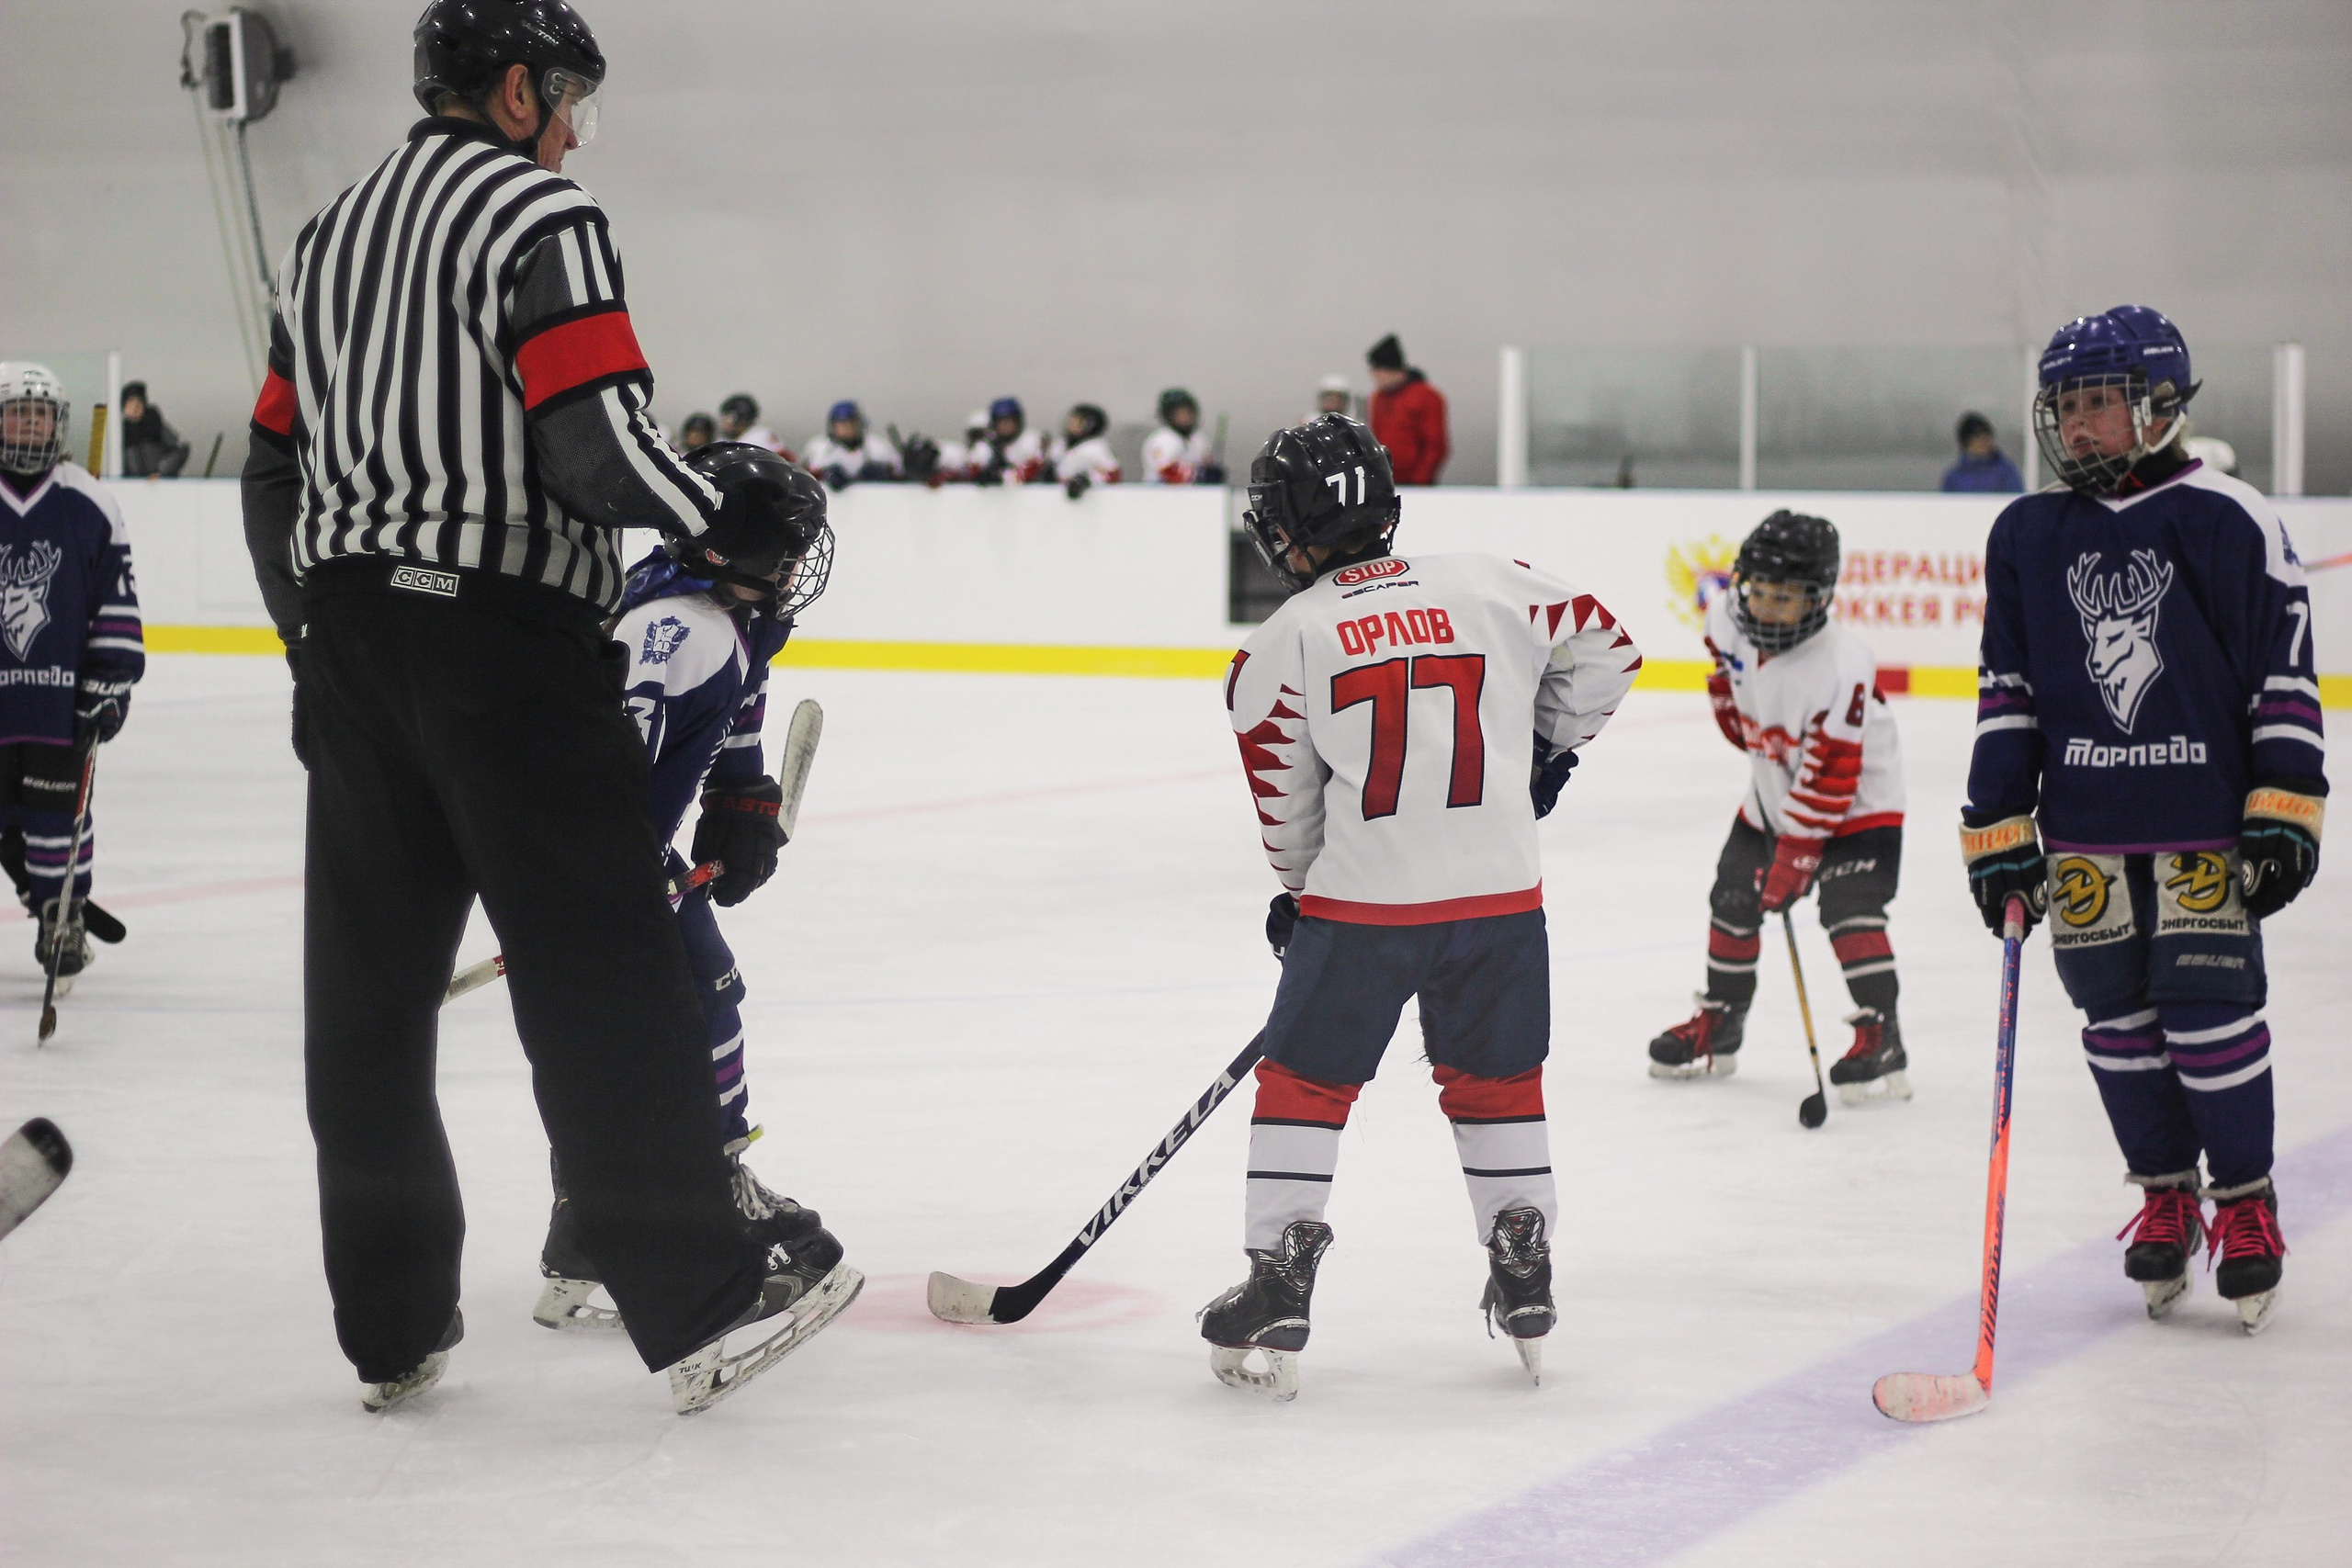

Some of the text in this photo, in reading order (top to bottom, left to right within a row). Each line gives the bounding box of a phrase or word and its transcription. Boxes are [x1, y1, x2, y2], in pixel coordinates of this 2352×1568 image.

[1325, 466, 1366, 507] 71
[395, 569, 456, 592] CCM
[1341, 581, 1419, 599] ESCAPER
[1344, 558, 1396, 582] STOP
[1336, 608, 1454, 657] ОРЛОВ
[2286, 600, 2309, 667] 7
[1330, 653, 1486, 821] 77
[2161, 917, 2245, 931] ЭНЕРГОСБЫТ
[1078, 1069, 1237, 1247] VIKKELA
